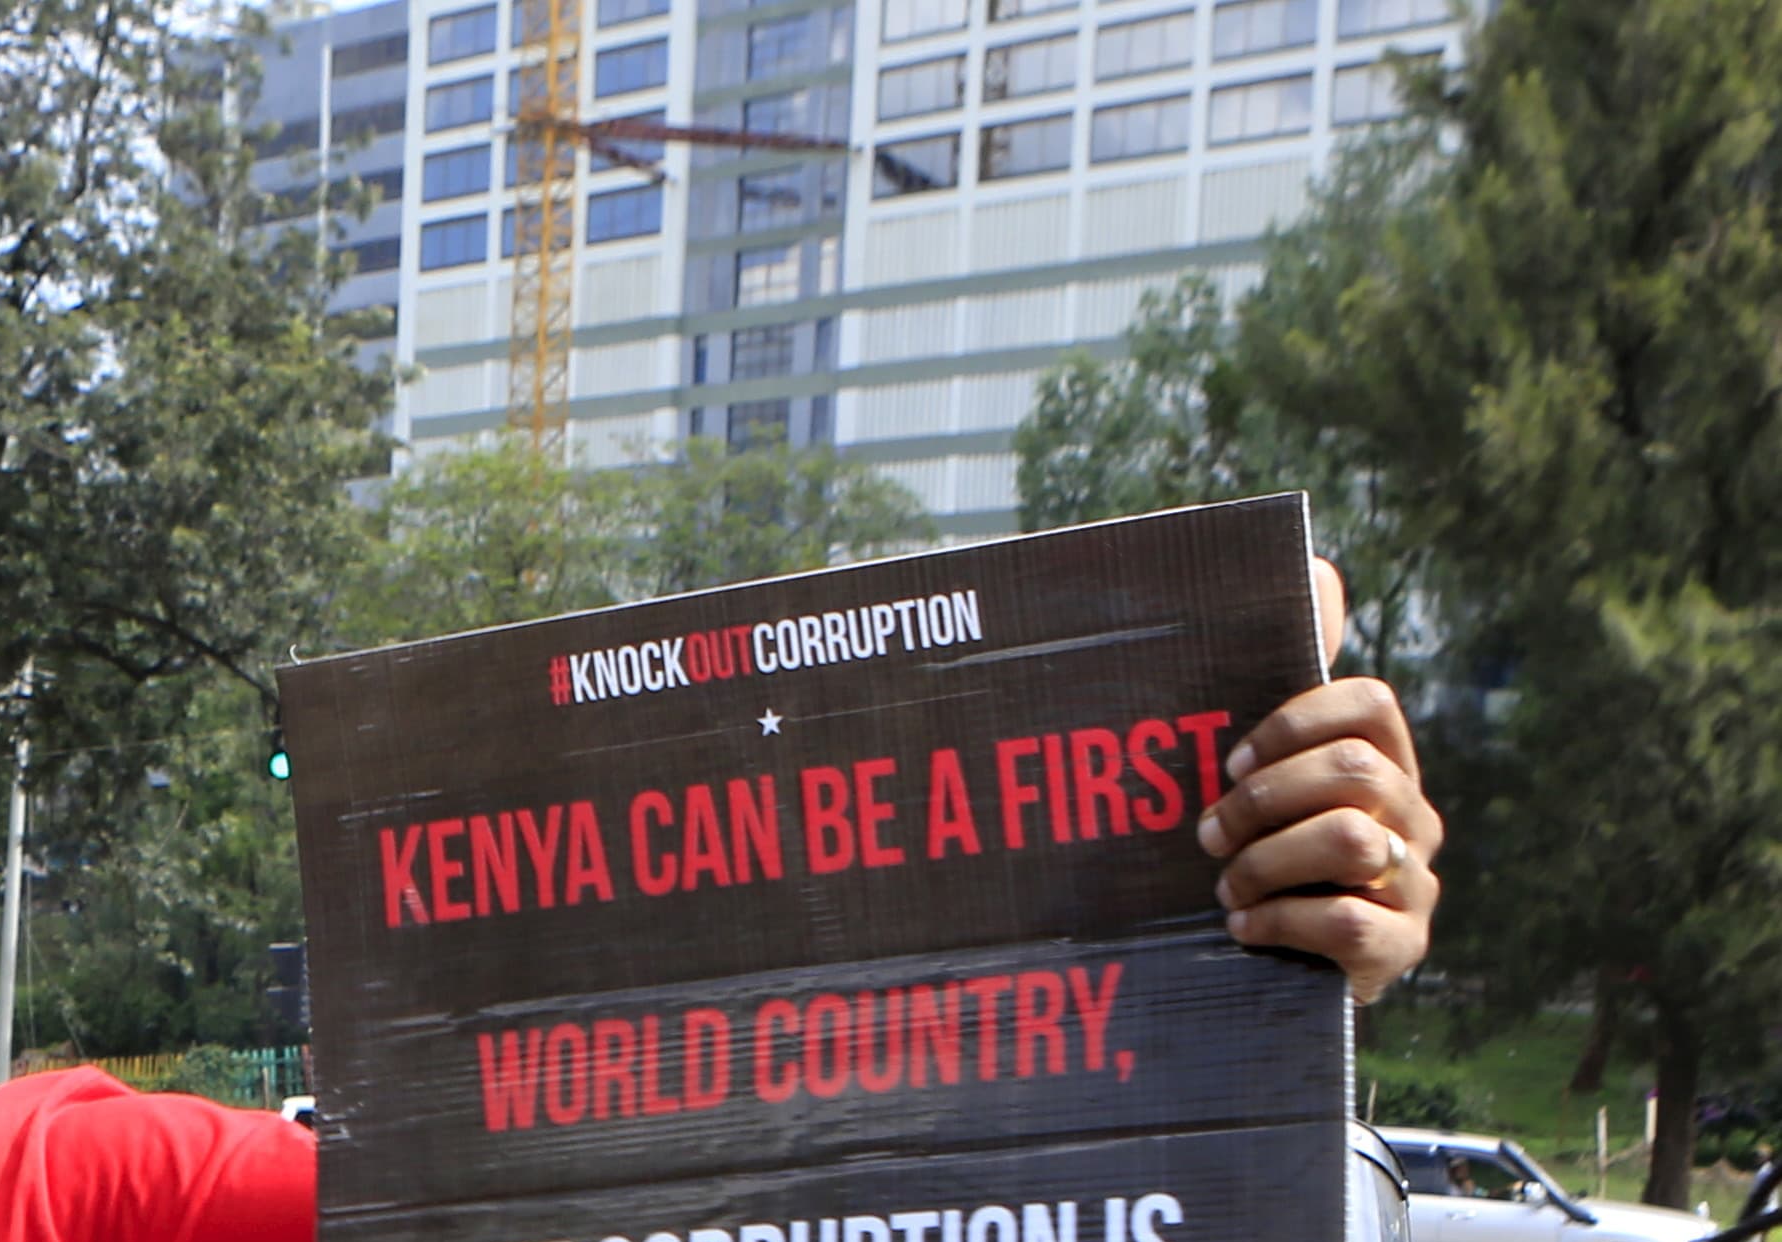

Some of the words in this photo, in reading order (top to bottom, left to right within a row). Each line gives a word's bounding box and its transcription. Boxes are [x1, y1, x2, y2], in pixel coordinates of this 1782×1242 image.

[549, 591, 982, 705] #KNOCKOUTCORRUPTION
[378, 799, 615, 928] KENYA
[629, 773, 784, 896] CAN
[800, 756, 906, 875] BE
[927, 747, 982, 860] A
[994, 711, 1231, 851] FIRST
[477, 1007, 732, 1133] WORLD
[753, 962, 1135, 1103] COUNTRY,
